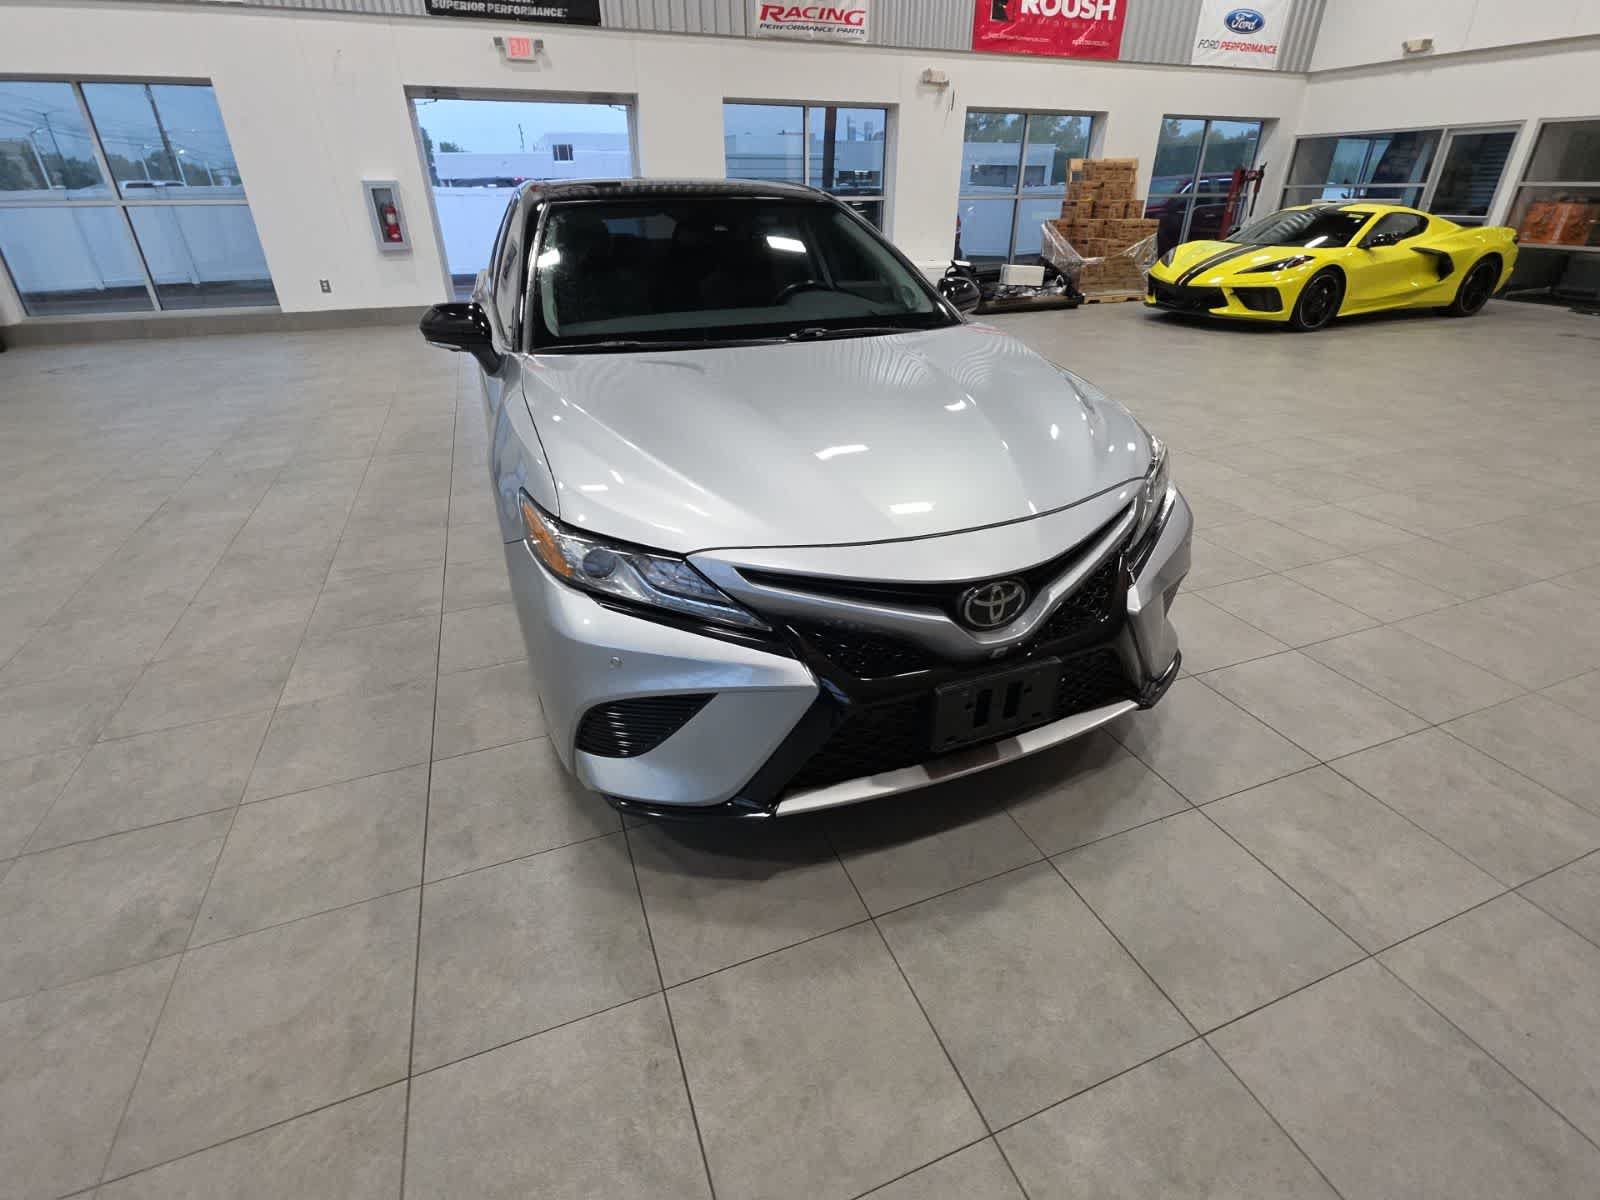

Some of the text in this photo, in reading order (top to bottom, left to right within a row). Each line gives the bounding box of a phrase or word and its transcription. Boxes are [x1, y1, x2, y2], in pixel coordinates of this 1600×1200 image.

[431, 0, 486, 12] SUPERIOR
[760, 4, 866, 26] RACING
[1231, 12, 1259, 31] Ford
[760, 23, 865, 35] PERFORMANCE PARTS
[1197, 39, 1278, 55] FORD PERFORMANCE
